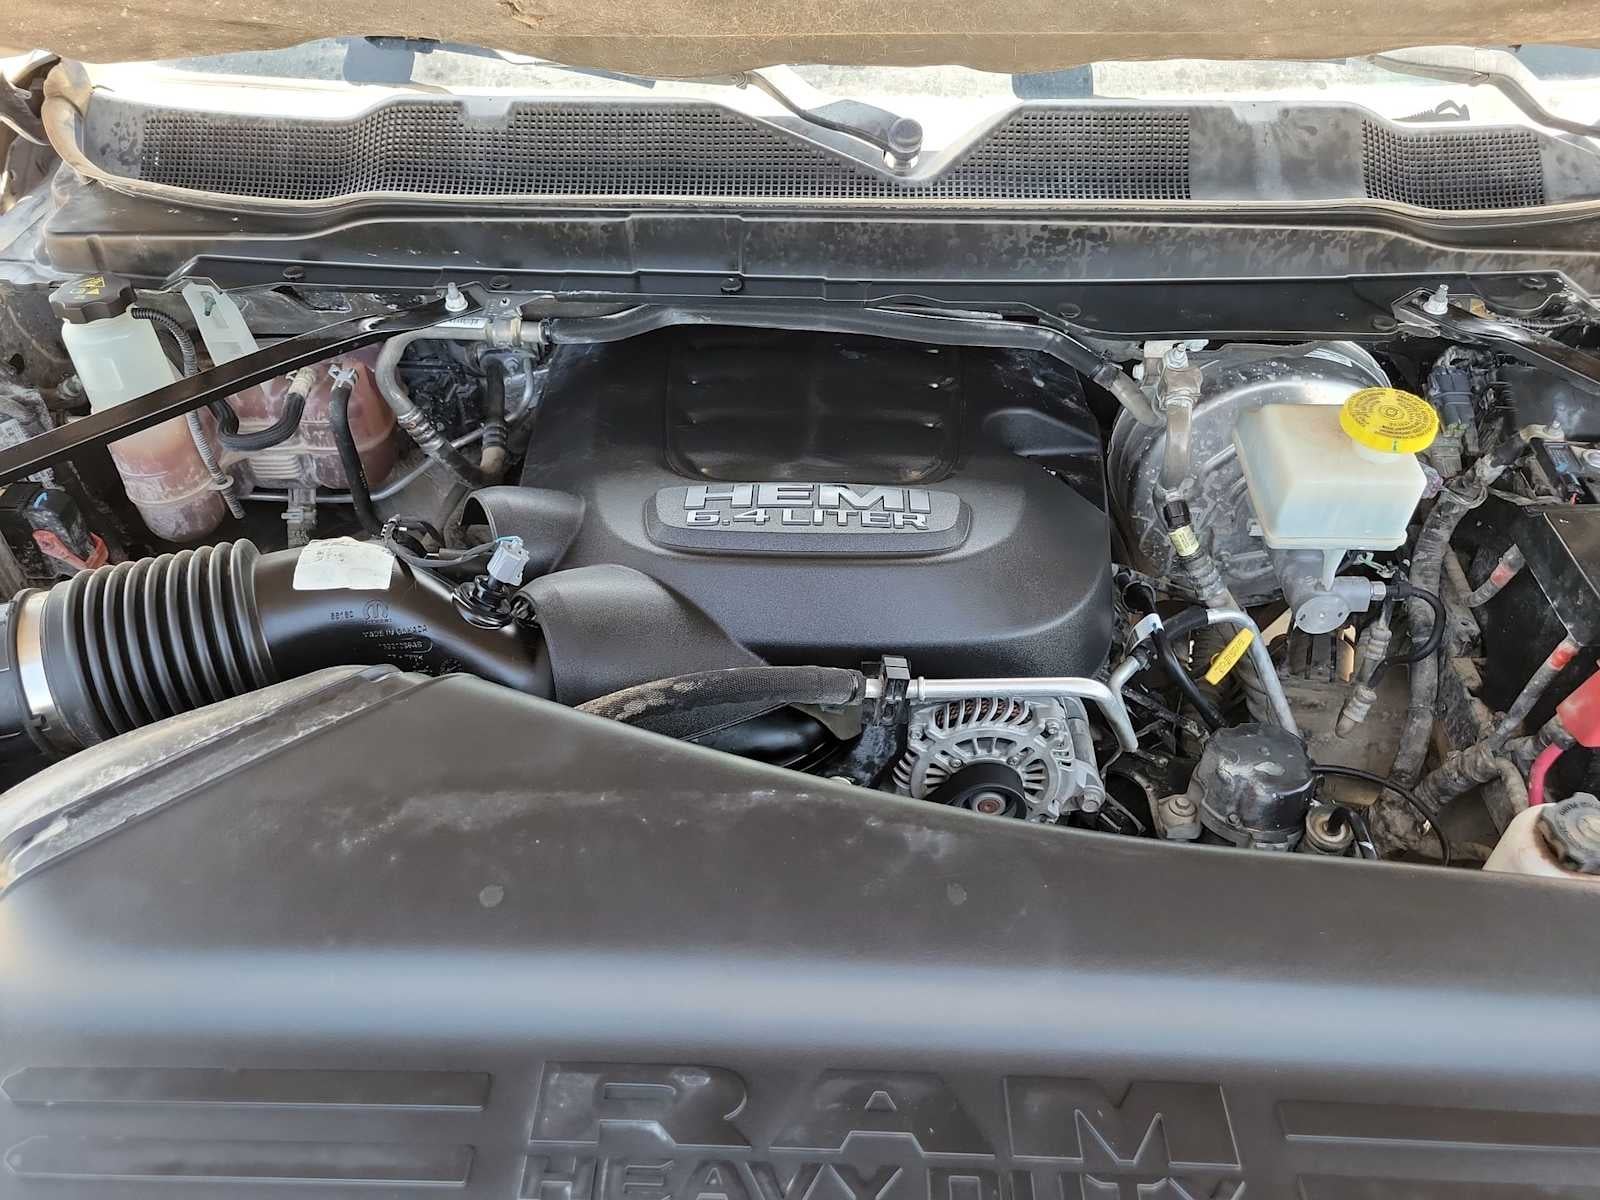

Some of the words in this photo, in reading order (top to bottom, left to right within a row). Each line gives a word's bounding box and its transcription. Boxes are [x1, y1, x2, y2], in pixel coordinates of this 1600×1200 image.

[684, 484, 931, 513] HEMI
[686, 509, 771, 527] 6.4
[781, 509, 929, 530] LITER
[529, 1061, 1242, 1169] RAM
[516, 1152, 904, 1200] HEAVY
